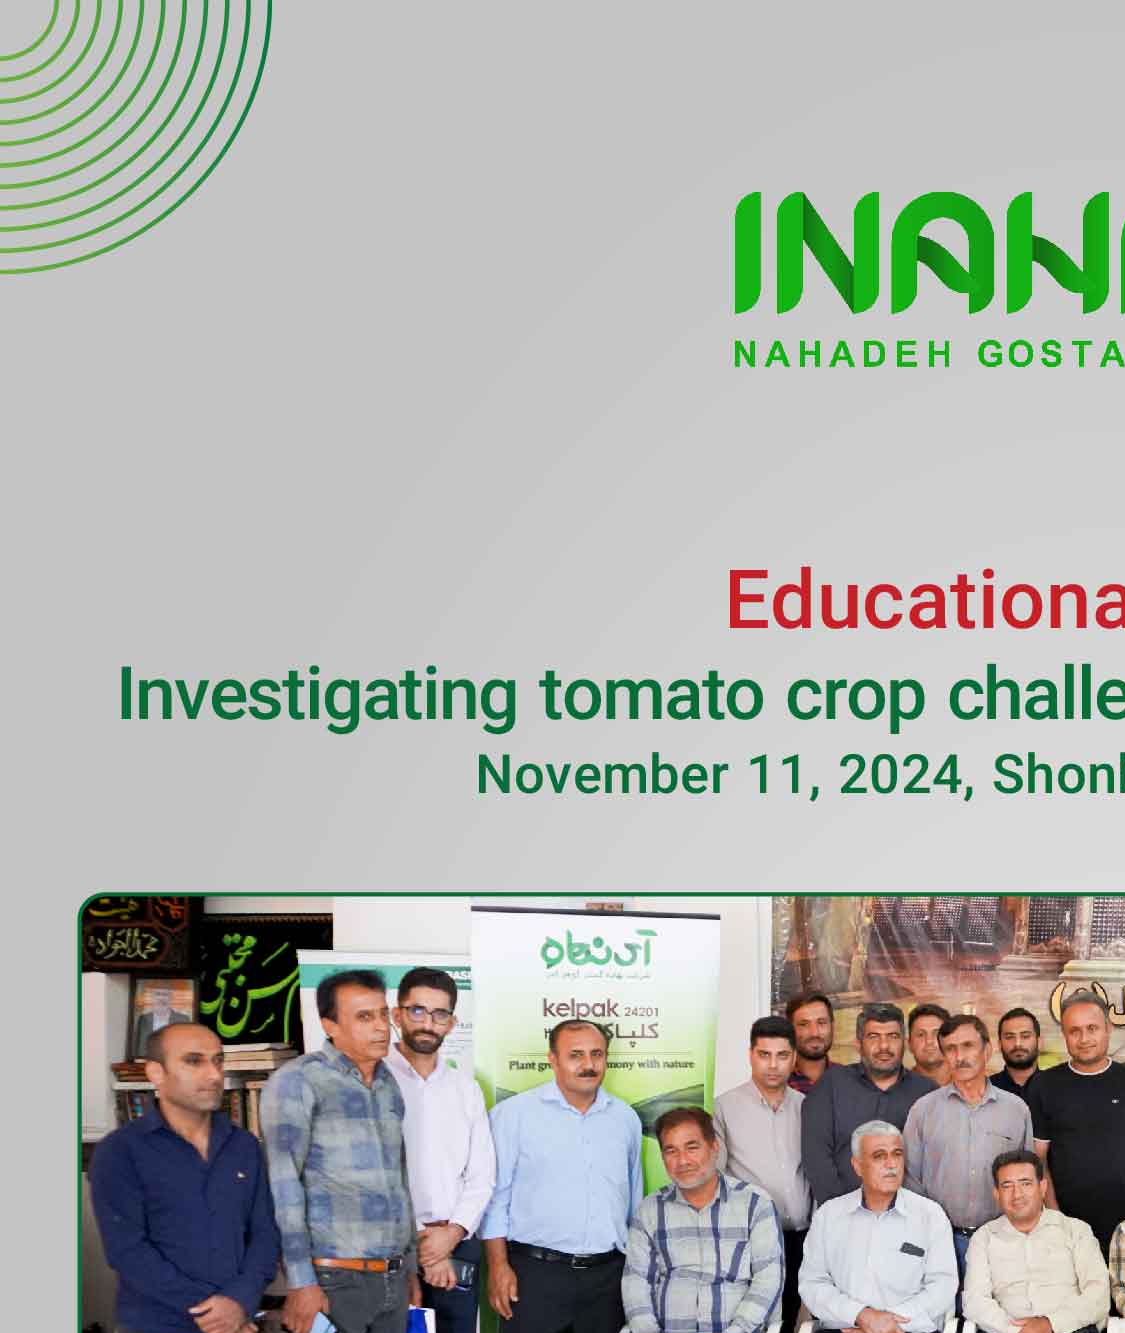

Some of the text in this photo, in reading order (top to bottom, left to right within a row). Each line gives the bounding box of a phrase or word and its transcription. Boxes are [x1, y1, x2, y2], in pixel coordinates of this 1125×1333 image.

[543, 998, 659, 1020] kelpak 24201
[509, 1060, 536, 1071] Plant
[663, 1060, 694, 1069] nature
